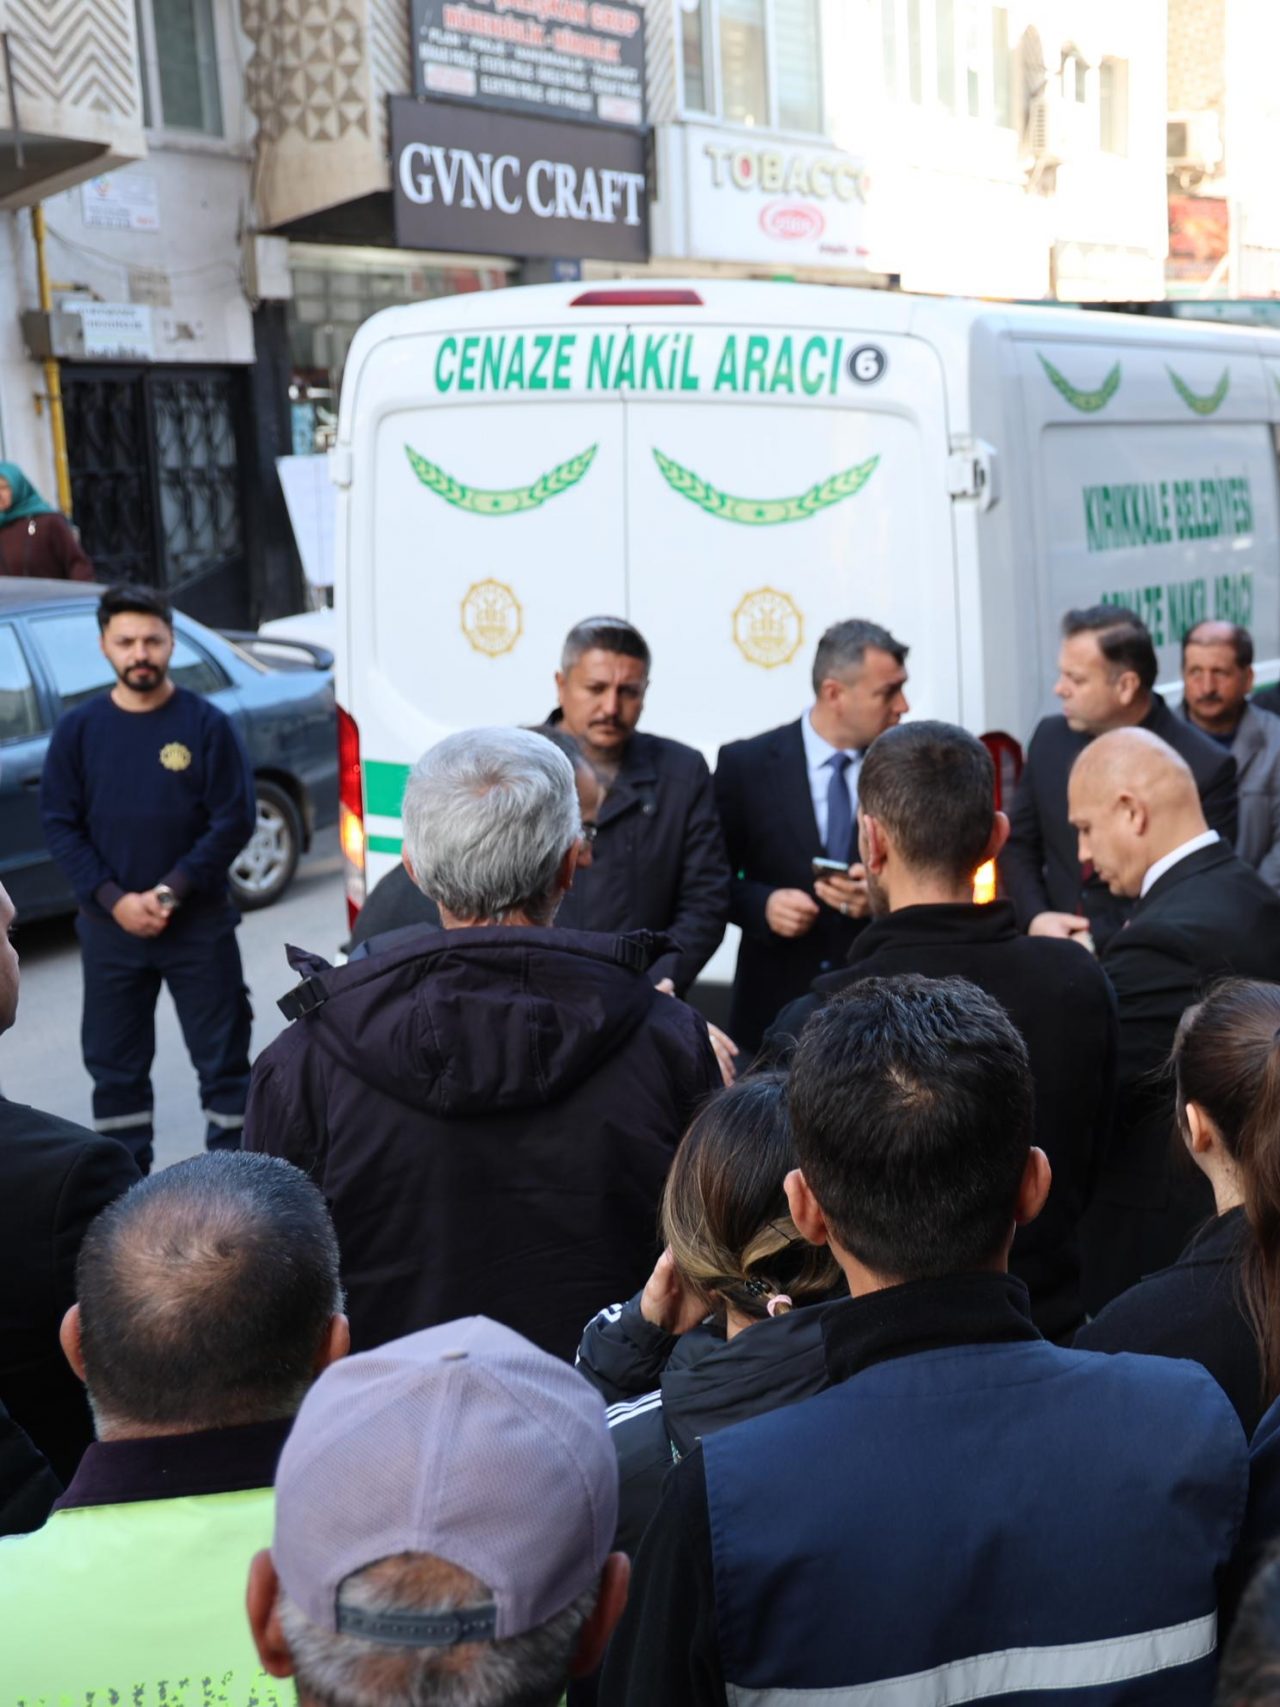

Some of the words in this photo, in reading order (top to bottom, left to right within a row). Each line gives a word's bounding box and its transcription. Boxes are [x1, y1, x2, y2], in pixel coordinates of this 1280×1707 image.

[399, 142, 523, 214] GVNC
[526, 159, 645, 226] CRAFT
[434, 335, 576, 393] CENAZE
[712, 334, 844, 396] ARACI
[854, 349, 880, 380] 6
[1082, 480, 1171, 553] KIRIKKALE
